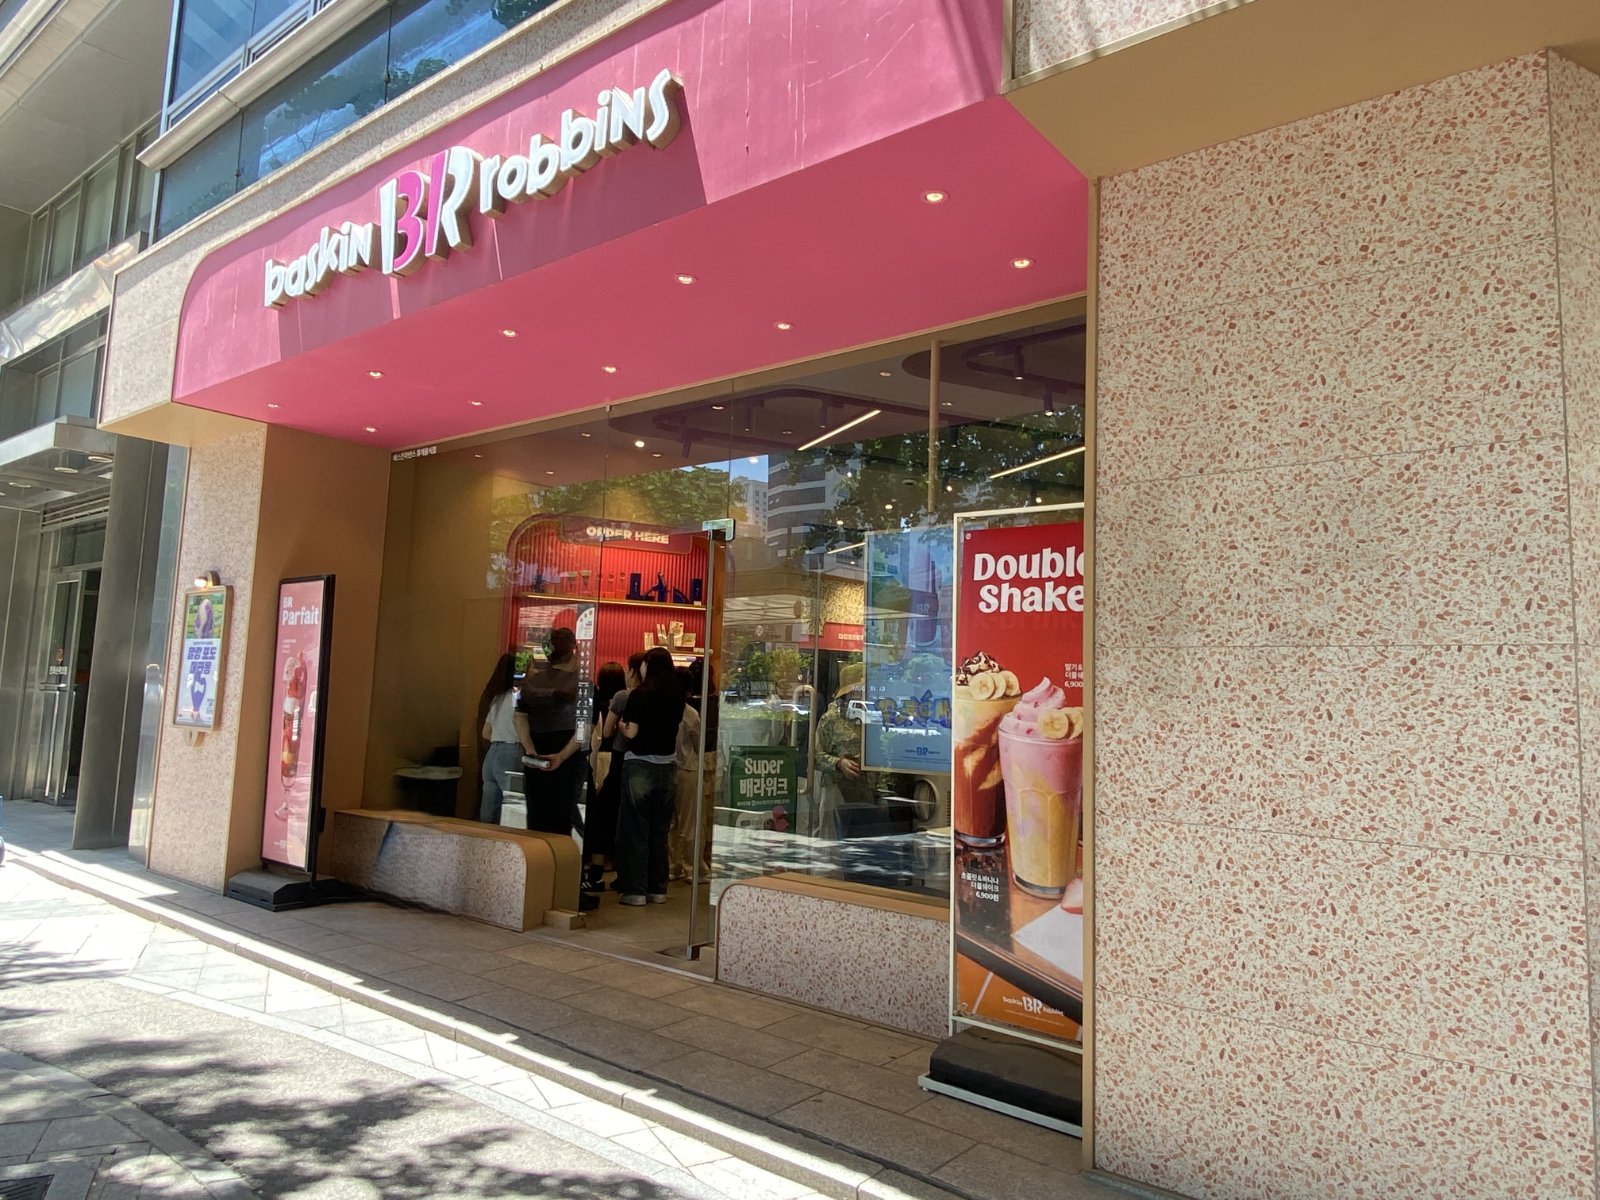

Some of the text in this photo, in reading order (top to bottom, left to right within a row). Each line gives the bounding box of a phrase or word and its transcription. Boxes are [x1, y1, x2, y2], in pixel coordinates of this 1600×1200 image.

[379, 145, 477, 278] BR
[586, 525, 670, 545] ORDER HERE
[978, 581, 1084, 614] Shake
[282, 605, 319, 626] Parfait
[744, 757, 784, 777] Super
[739, 777, 788, 798] 배라위크
[1022, 996, 1043, 1015] BR
